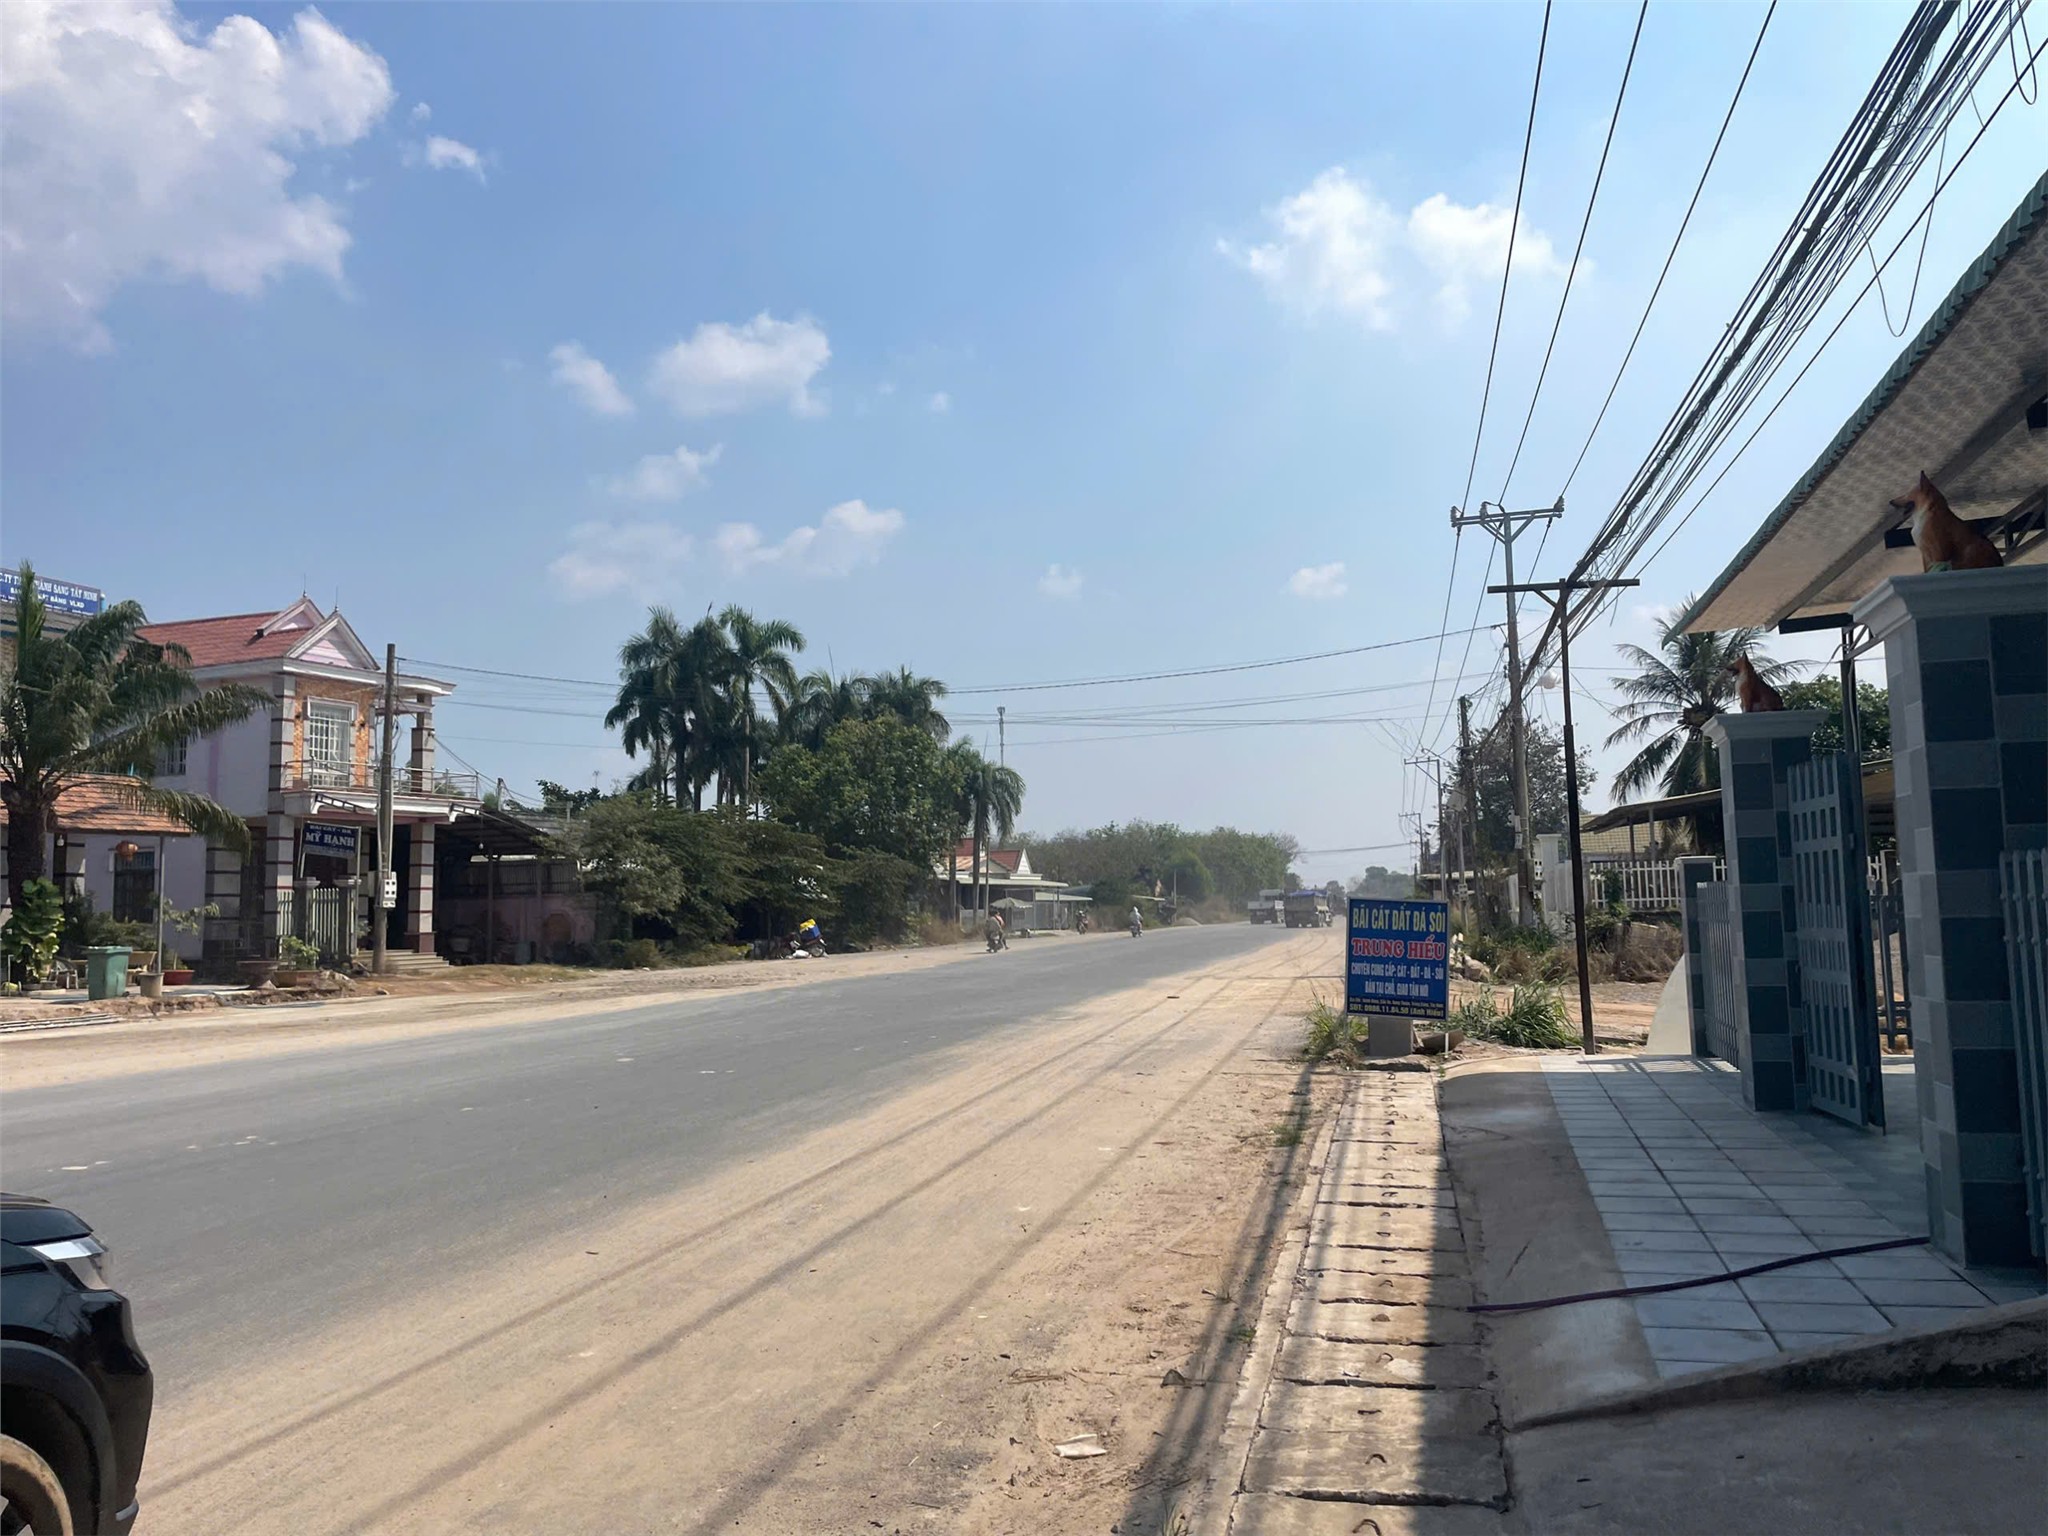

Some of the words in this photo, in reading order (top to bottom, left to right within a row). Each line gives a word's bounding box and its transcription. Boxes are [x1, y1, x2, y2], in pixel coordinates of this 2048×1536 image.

[53, 583, 69, 596] SANG
[70, 585, 82, 599] TÂY
[83, 589, 98, 602] NINH
[305, 831, 321, 843] MỸ
[323, 834, 354, 848] HẠNH
[1353, 904, 1369, 929] BÃI
[1371, 905, 1390, 930] CÁT
[1392, 903, 1411, 931] ĐẤT
[1413, 906, 1427, 933] ĐÁ
[1429, 905, 1446, 933] SỎI
[1352, 938, 1404, 958] TRUNG
[1407, 934, 1445, 960] HIẾU
[1371, 963, 1384, 976] CUNG
[1397, 962, 1407, 978] CÁT
[1397, 983, 1408, 996] GIAO
